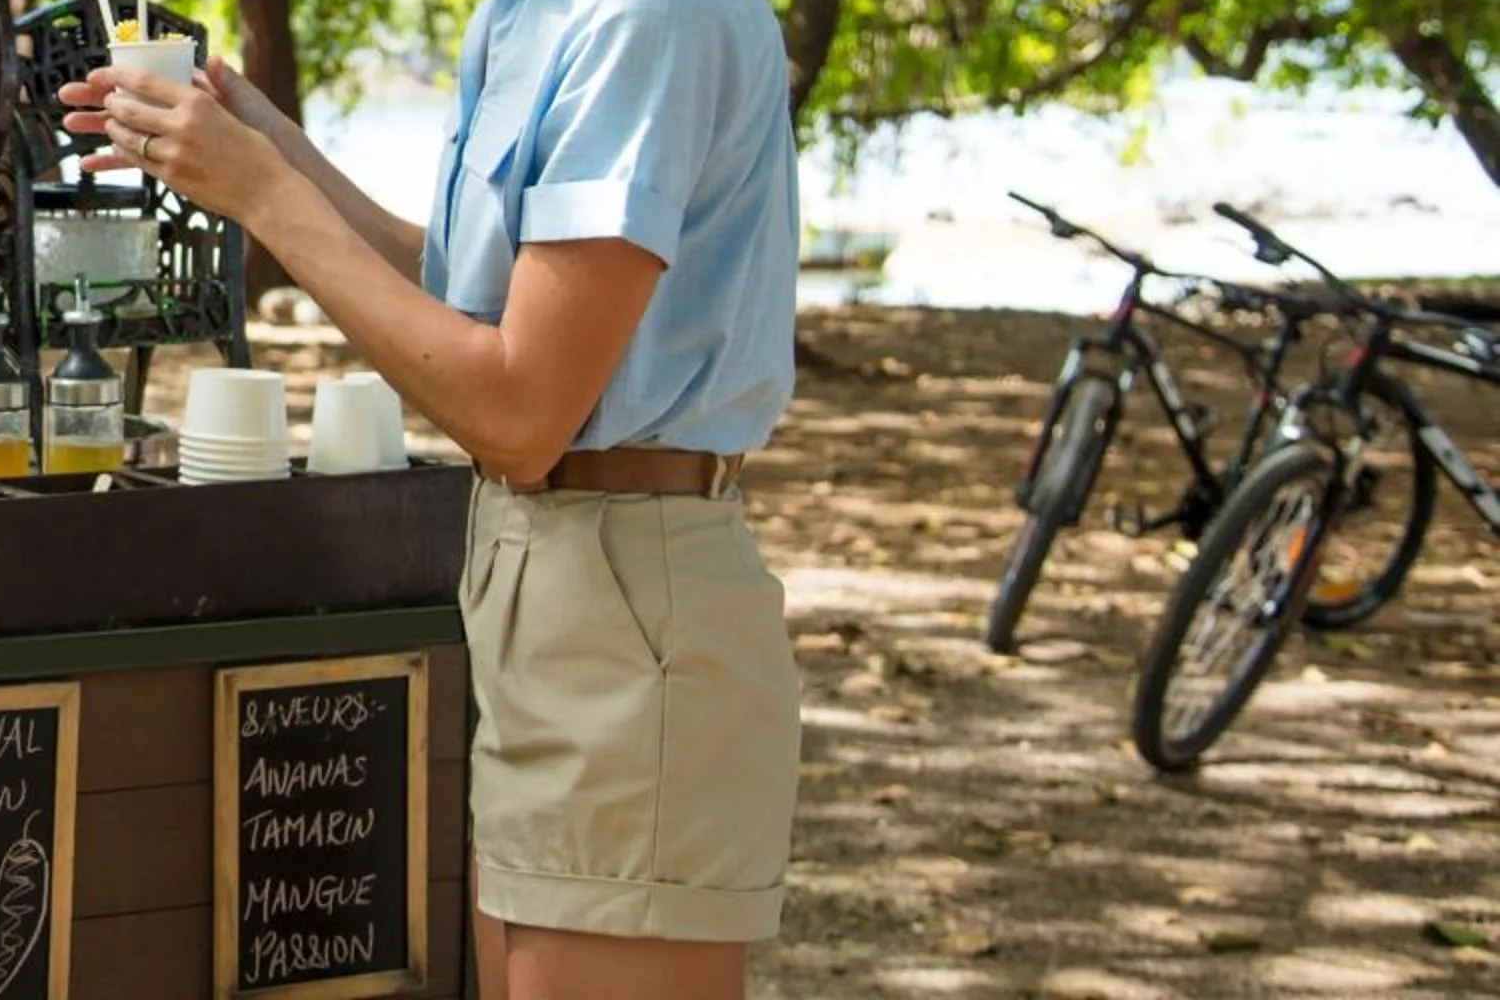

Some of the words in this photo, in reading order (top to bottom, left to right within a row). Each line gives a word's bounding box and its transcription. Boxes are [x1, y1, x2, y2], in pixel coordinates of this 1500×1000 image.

[244, 753, 368, 797] ANANAS
[242, 807, 375, 851] TAMARIN
[244, 873, 377, 923] MANGUE
[244, 921, 375, 984] PASSION
